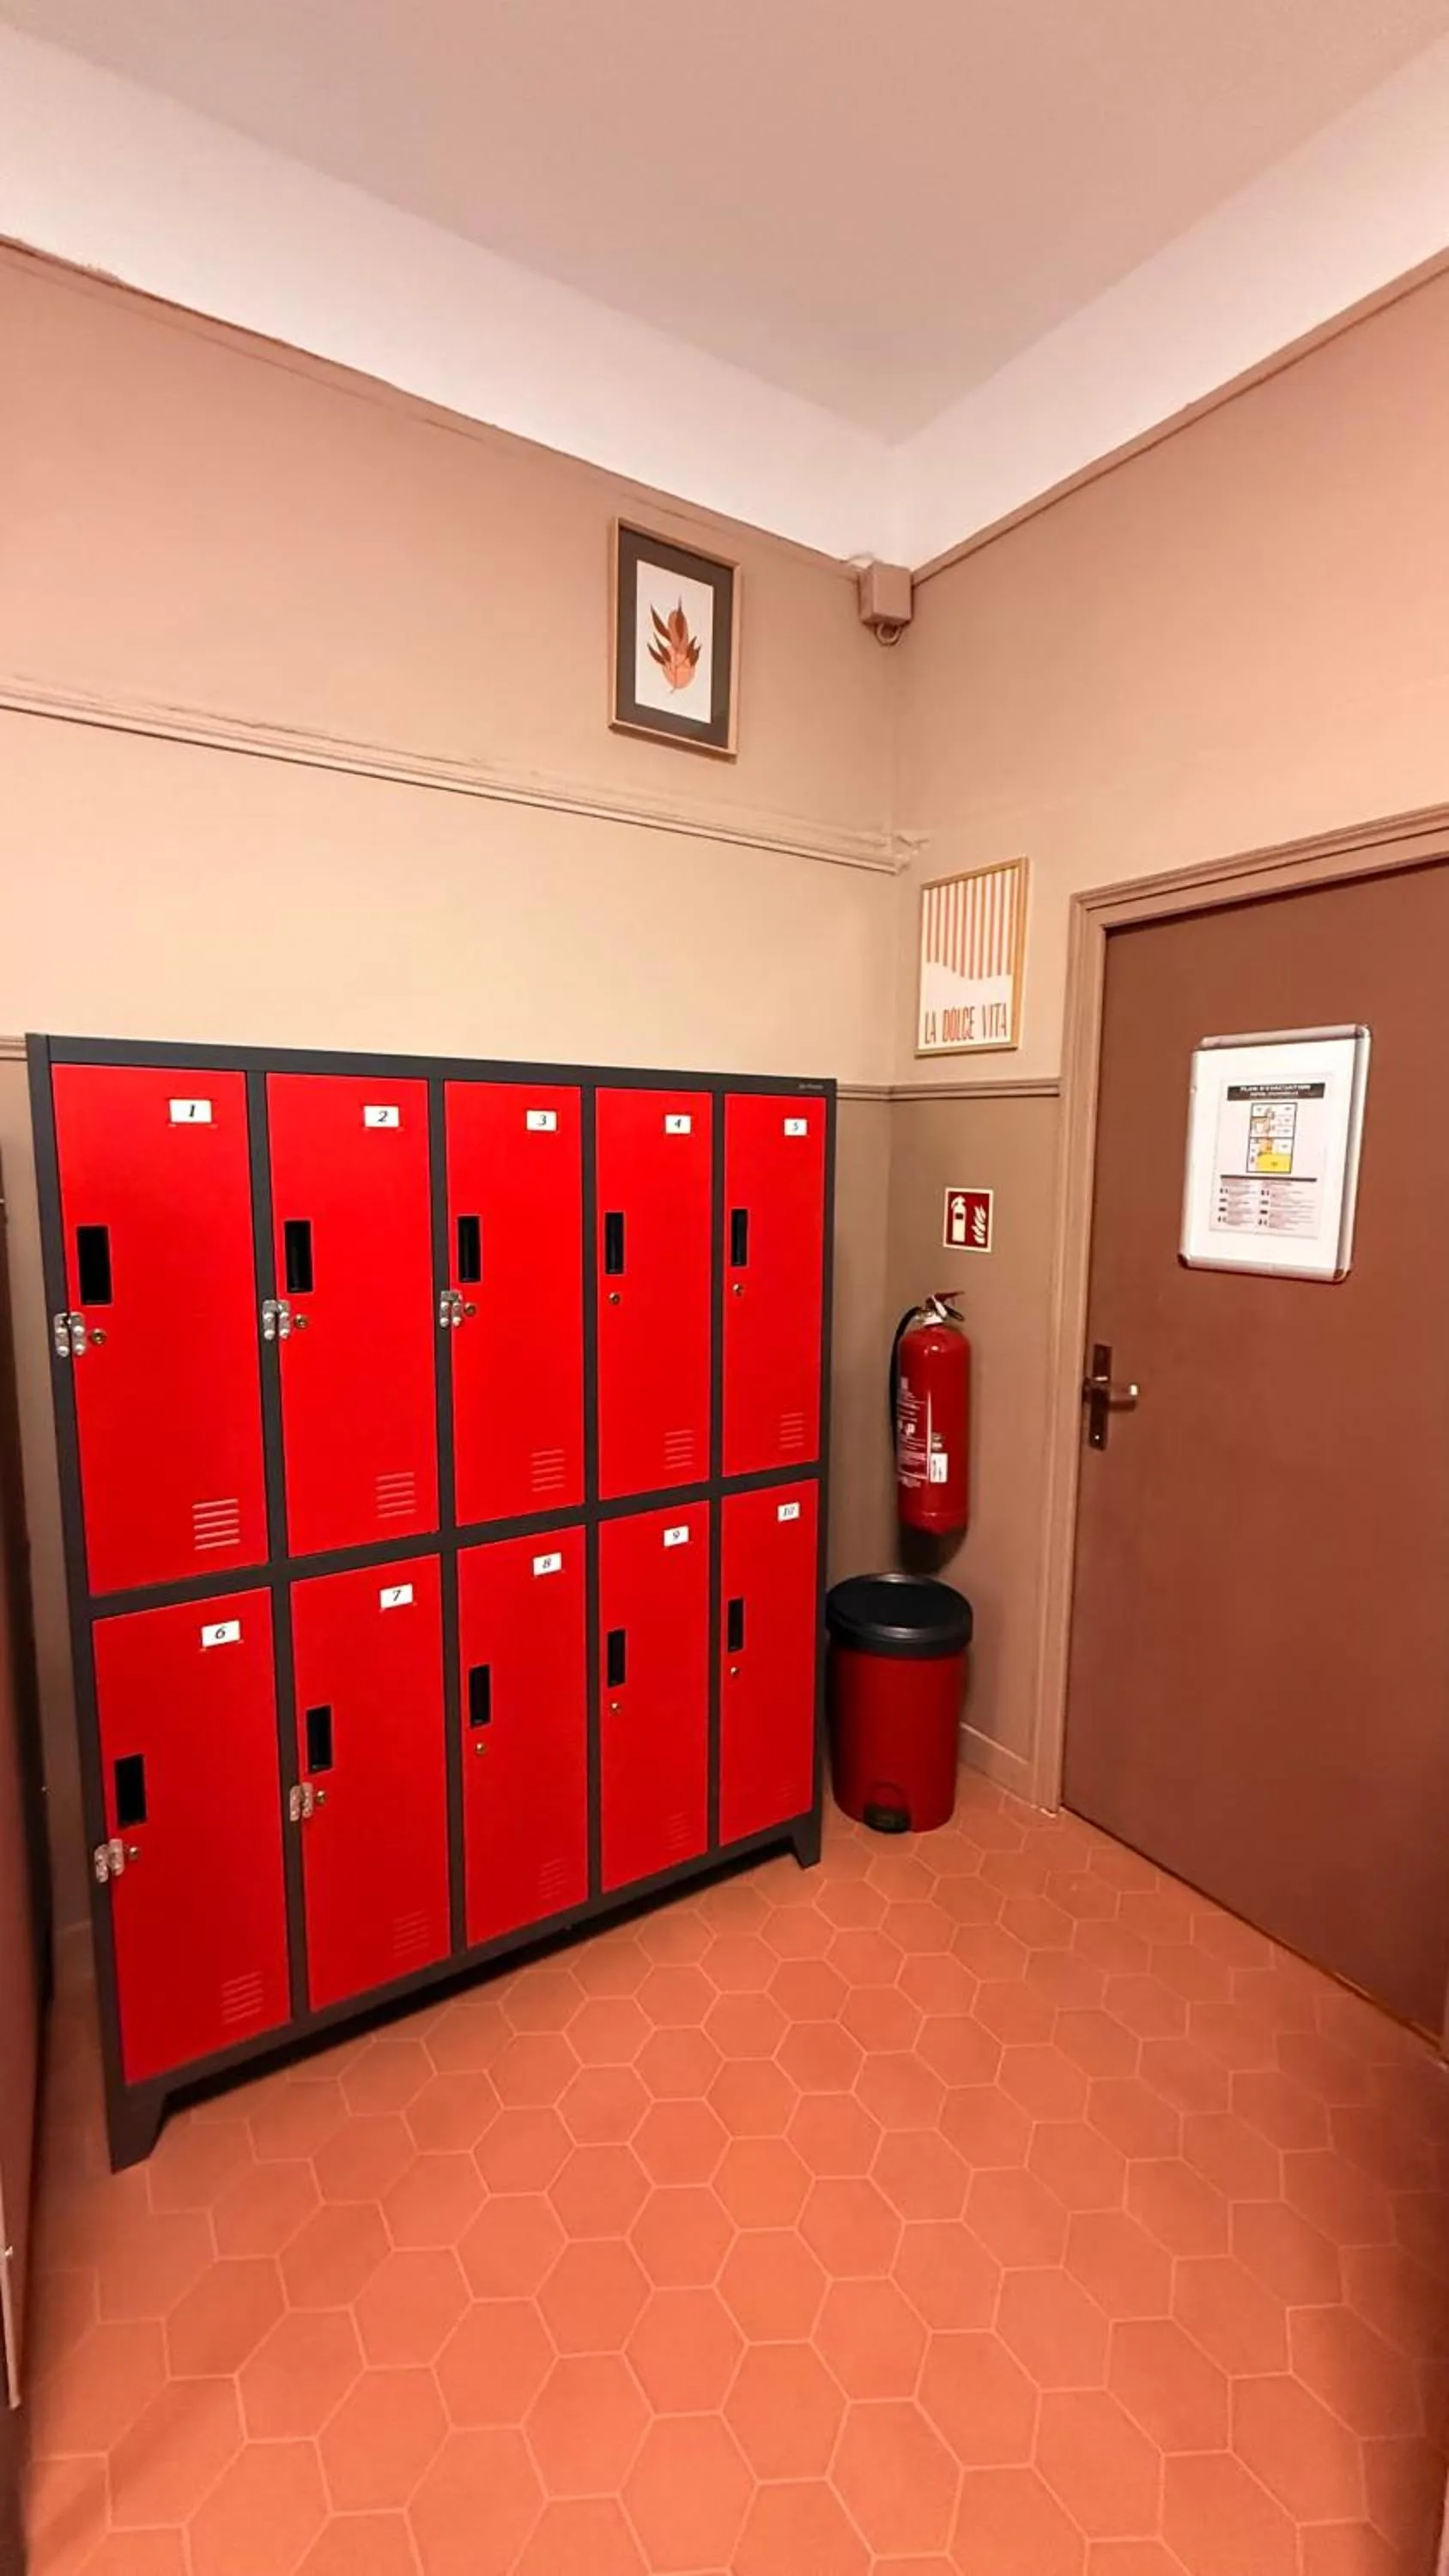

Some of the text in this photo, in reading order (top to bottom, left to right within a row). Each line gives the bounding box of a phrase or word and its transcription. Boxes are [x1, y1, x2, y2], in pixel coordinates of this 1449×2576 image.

[925, 1002, 1007, 1044] LA DOLCE VITA
[188, 1103, 196, 1118] 1
[377, 1109, 388, 1123] 2
[537, 1115, 547, 1127] 3
[673, 1118, 682, 1129] 4
[791, 1121, 799, 1132] 5
[671, 1529, 681, 1541] 9
[542, 1558, 552, 1570] 8
[392, 1589, 402, 1602] 7
[215, 1625, 227, 1639] 6
